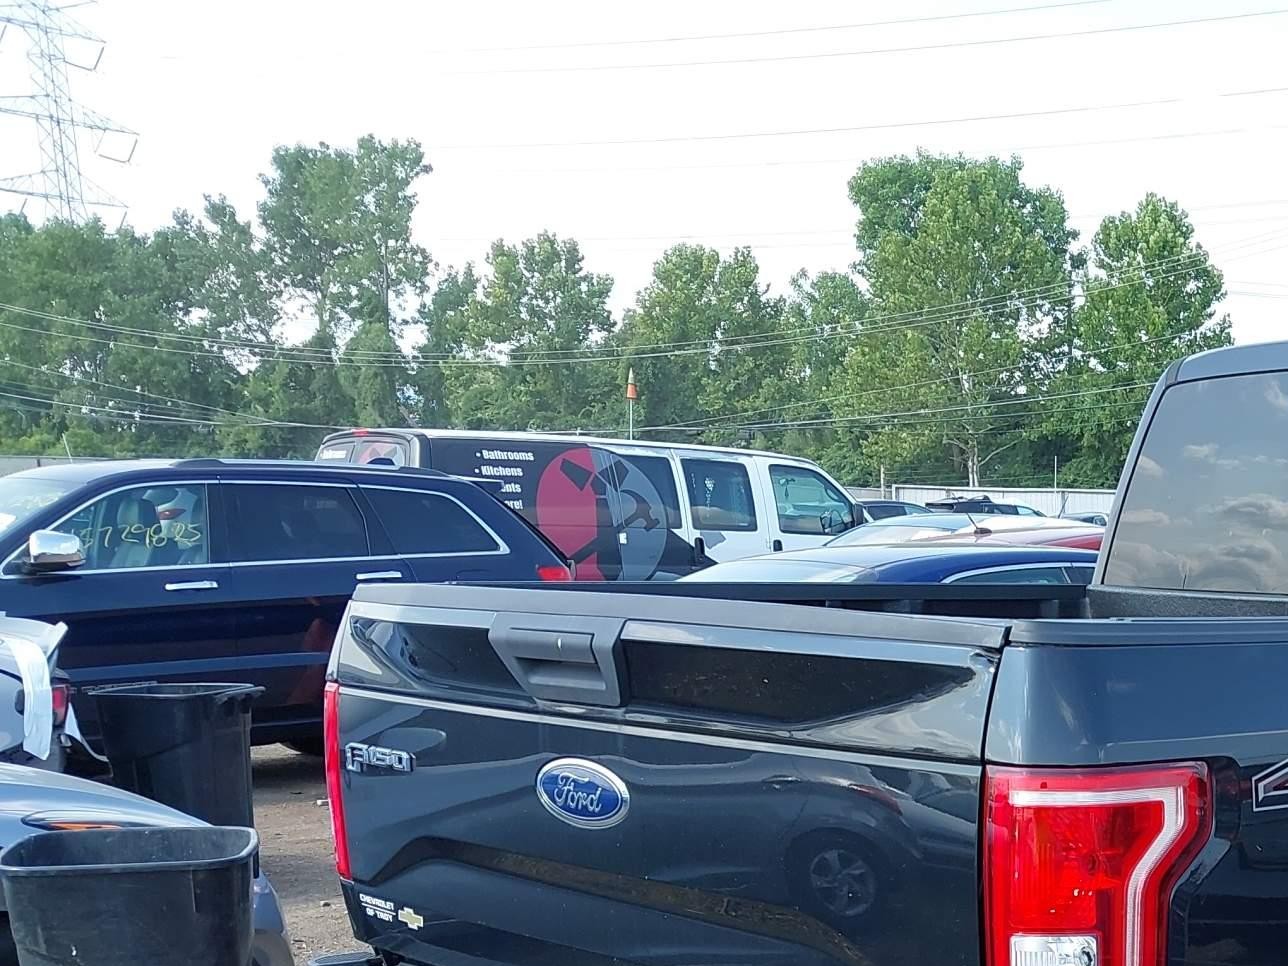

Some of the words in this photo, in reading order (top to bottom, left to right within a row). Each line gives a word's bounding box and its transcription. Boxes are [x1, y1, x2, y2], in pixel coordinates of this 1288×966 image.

[482, 449, 534, 461] Bathrooms
[481, 465, 523, 476] Kitchens
[554, 772, 602, 813] Ford
[359, 893, 395, 911] CHEVROLET
